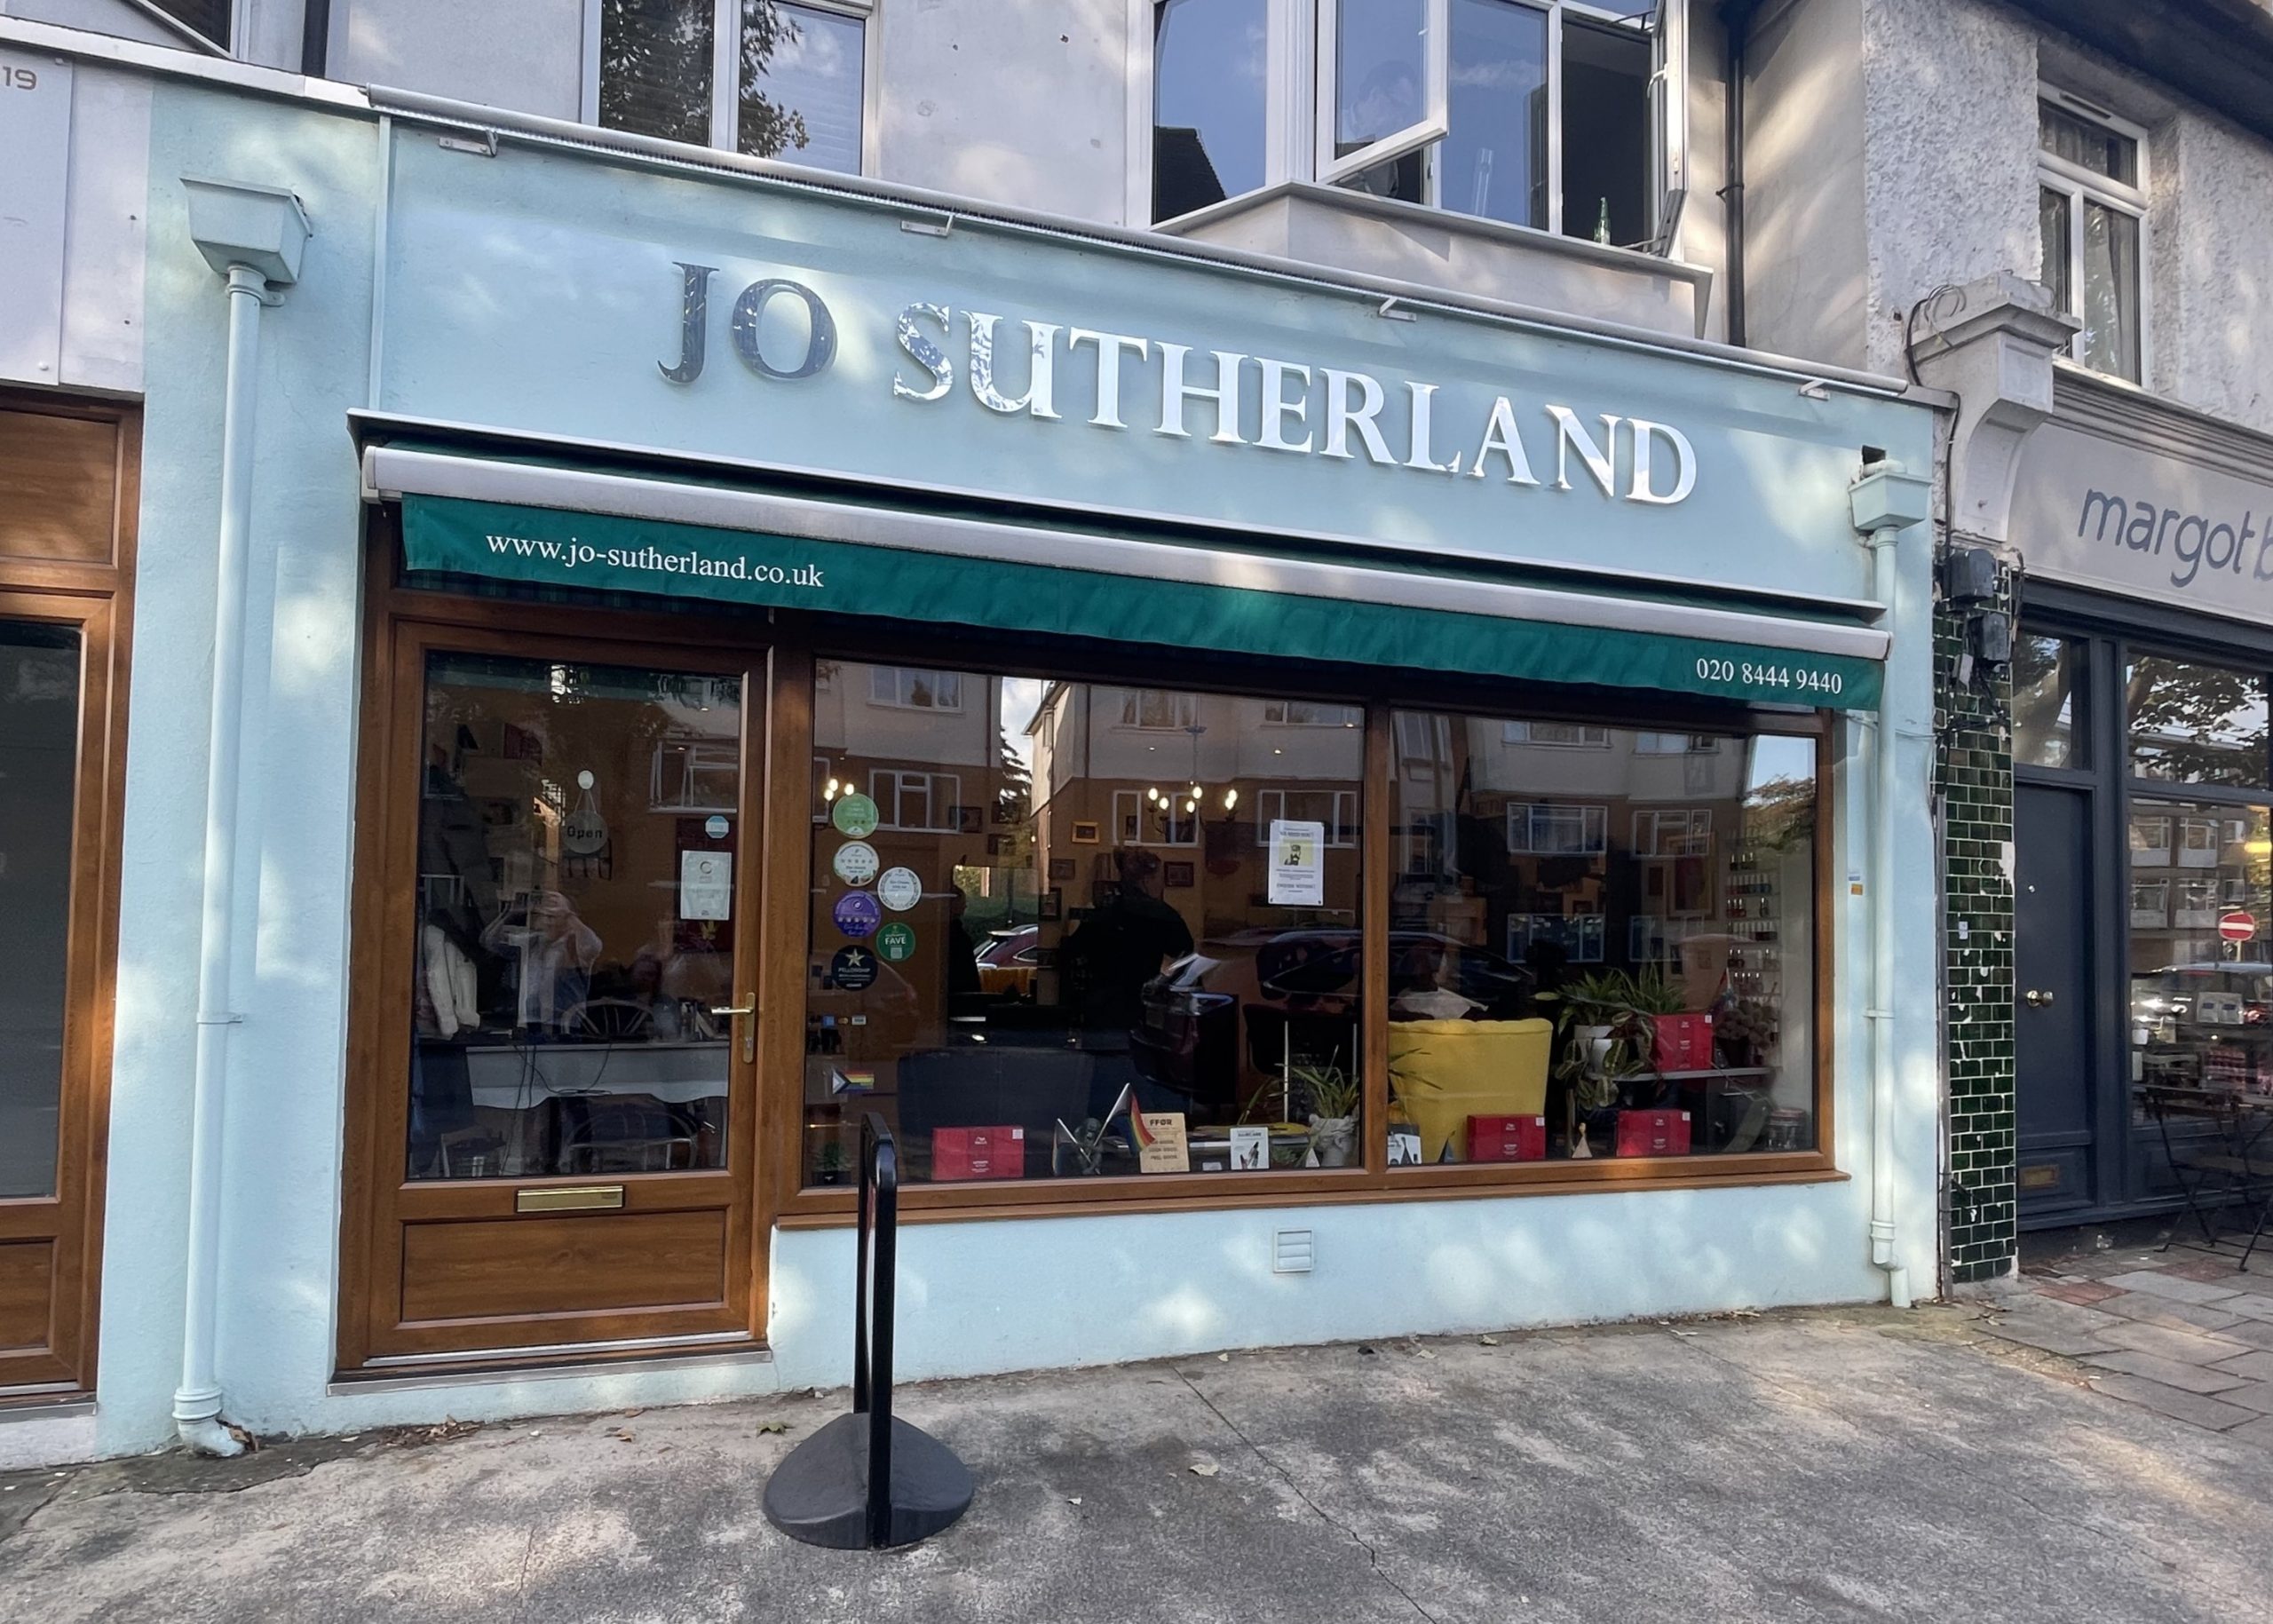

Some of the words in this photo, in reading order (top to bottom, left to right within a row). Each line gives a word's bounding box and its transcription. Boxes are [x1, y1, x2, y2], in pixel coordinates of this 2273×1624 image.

[3, 66, 37, 91] 19
[657, 261, 837, 384] JO
[892, 302, 1698, 504] SUTHERLAND
[485, 535, 825, 588] www.jo-sutherland.co.uk
[1696, 658, 1735, 682] 020
[1741, 662, 1790, 688] 8444
[1795, 669, 1842, 694] 9440
[567, 825, 603, 840] Open
[884, 937, 907, 946] FAVE
